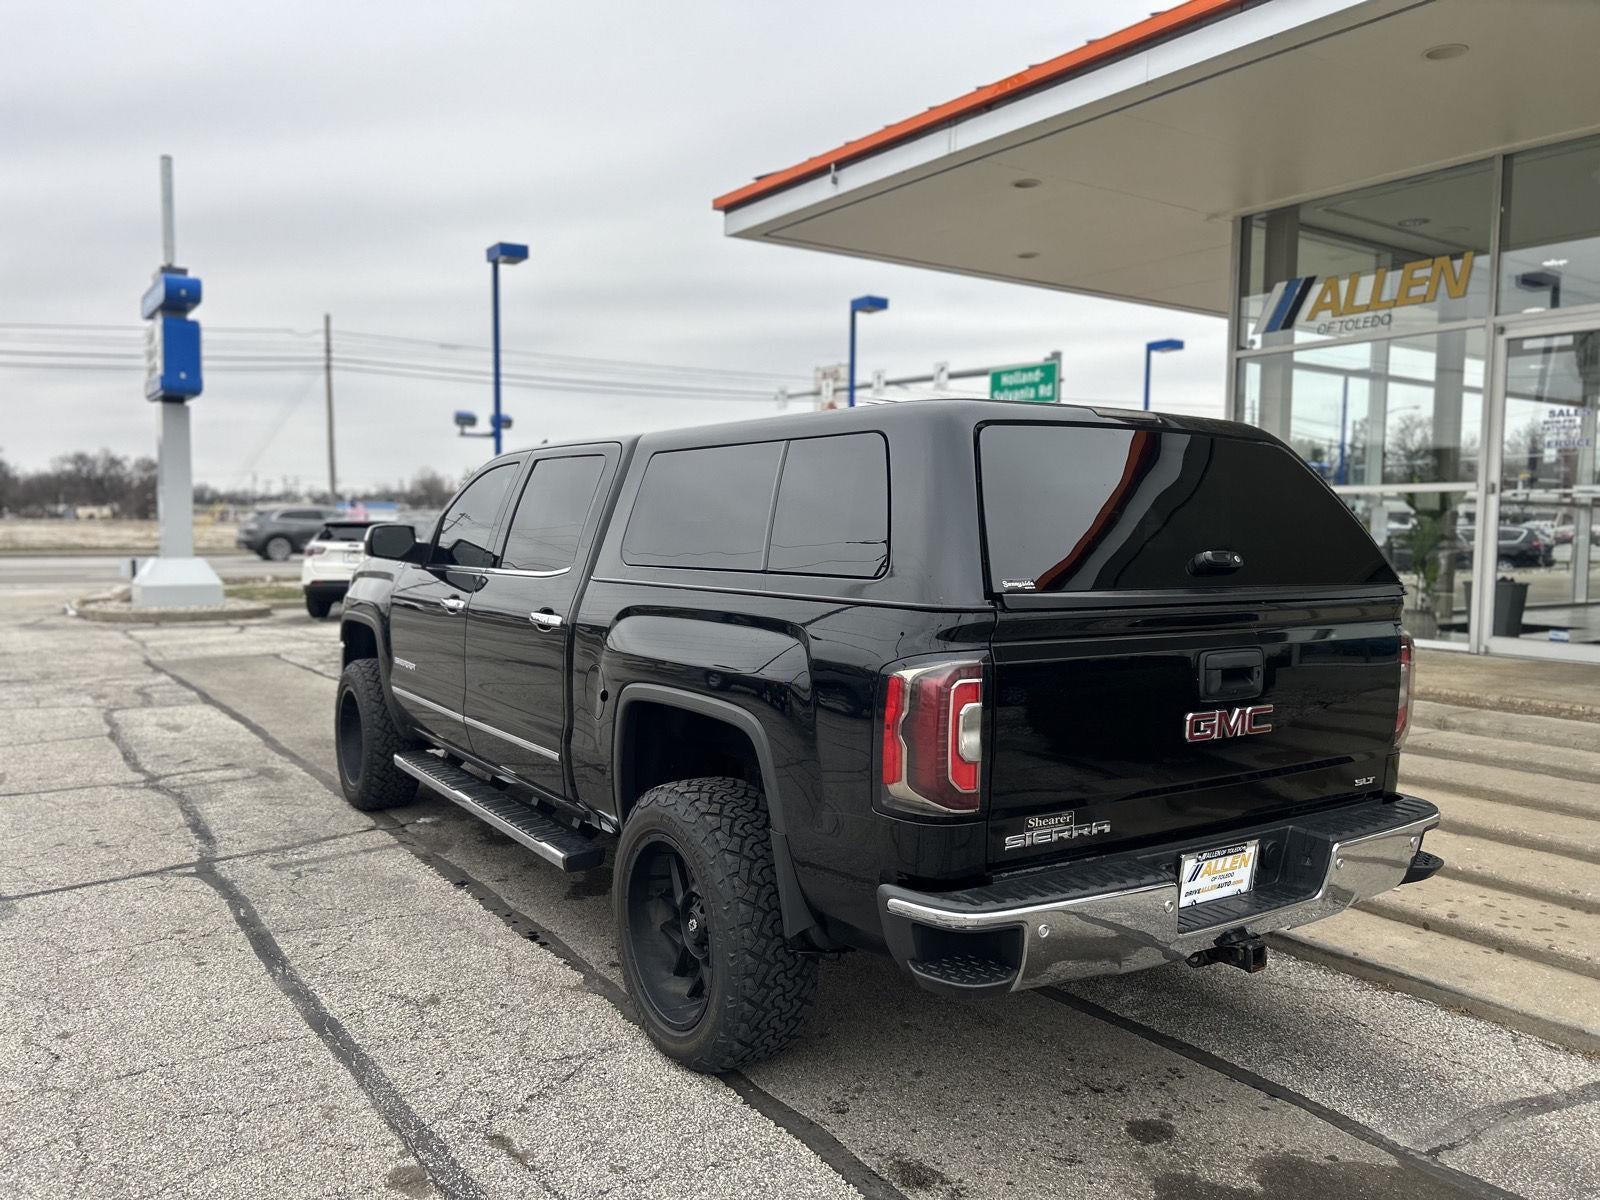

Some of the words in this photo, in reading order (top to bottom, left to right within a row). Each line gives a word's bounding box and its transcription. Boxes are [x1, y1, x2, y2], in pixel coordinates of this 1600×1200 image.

[1306, 250, 1474, 322] ALLEN
[1316, 322, 1338, 336] OF
[1339, 313, 1393, 333] TOLEDO
[1001, 370, 1044, 386] Holland-
[1038, 383, 1053, 397] Rd
[1184, 704, 1274, 743] GMC
[1354, 775, 1376, 787] SLT
[1027, 814, 1073, 828] Shearer
[1004, 820, 1112, 851] SIERRA
[1206, 850, 1220, 858] ALLEN
[1200, 852, 1253, 878] ALLEN
[1218, 872, 1234, 880] TOLEDO
